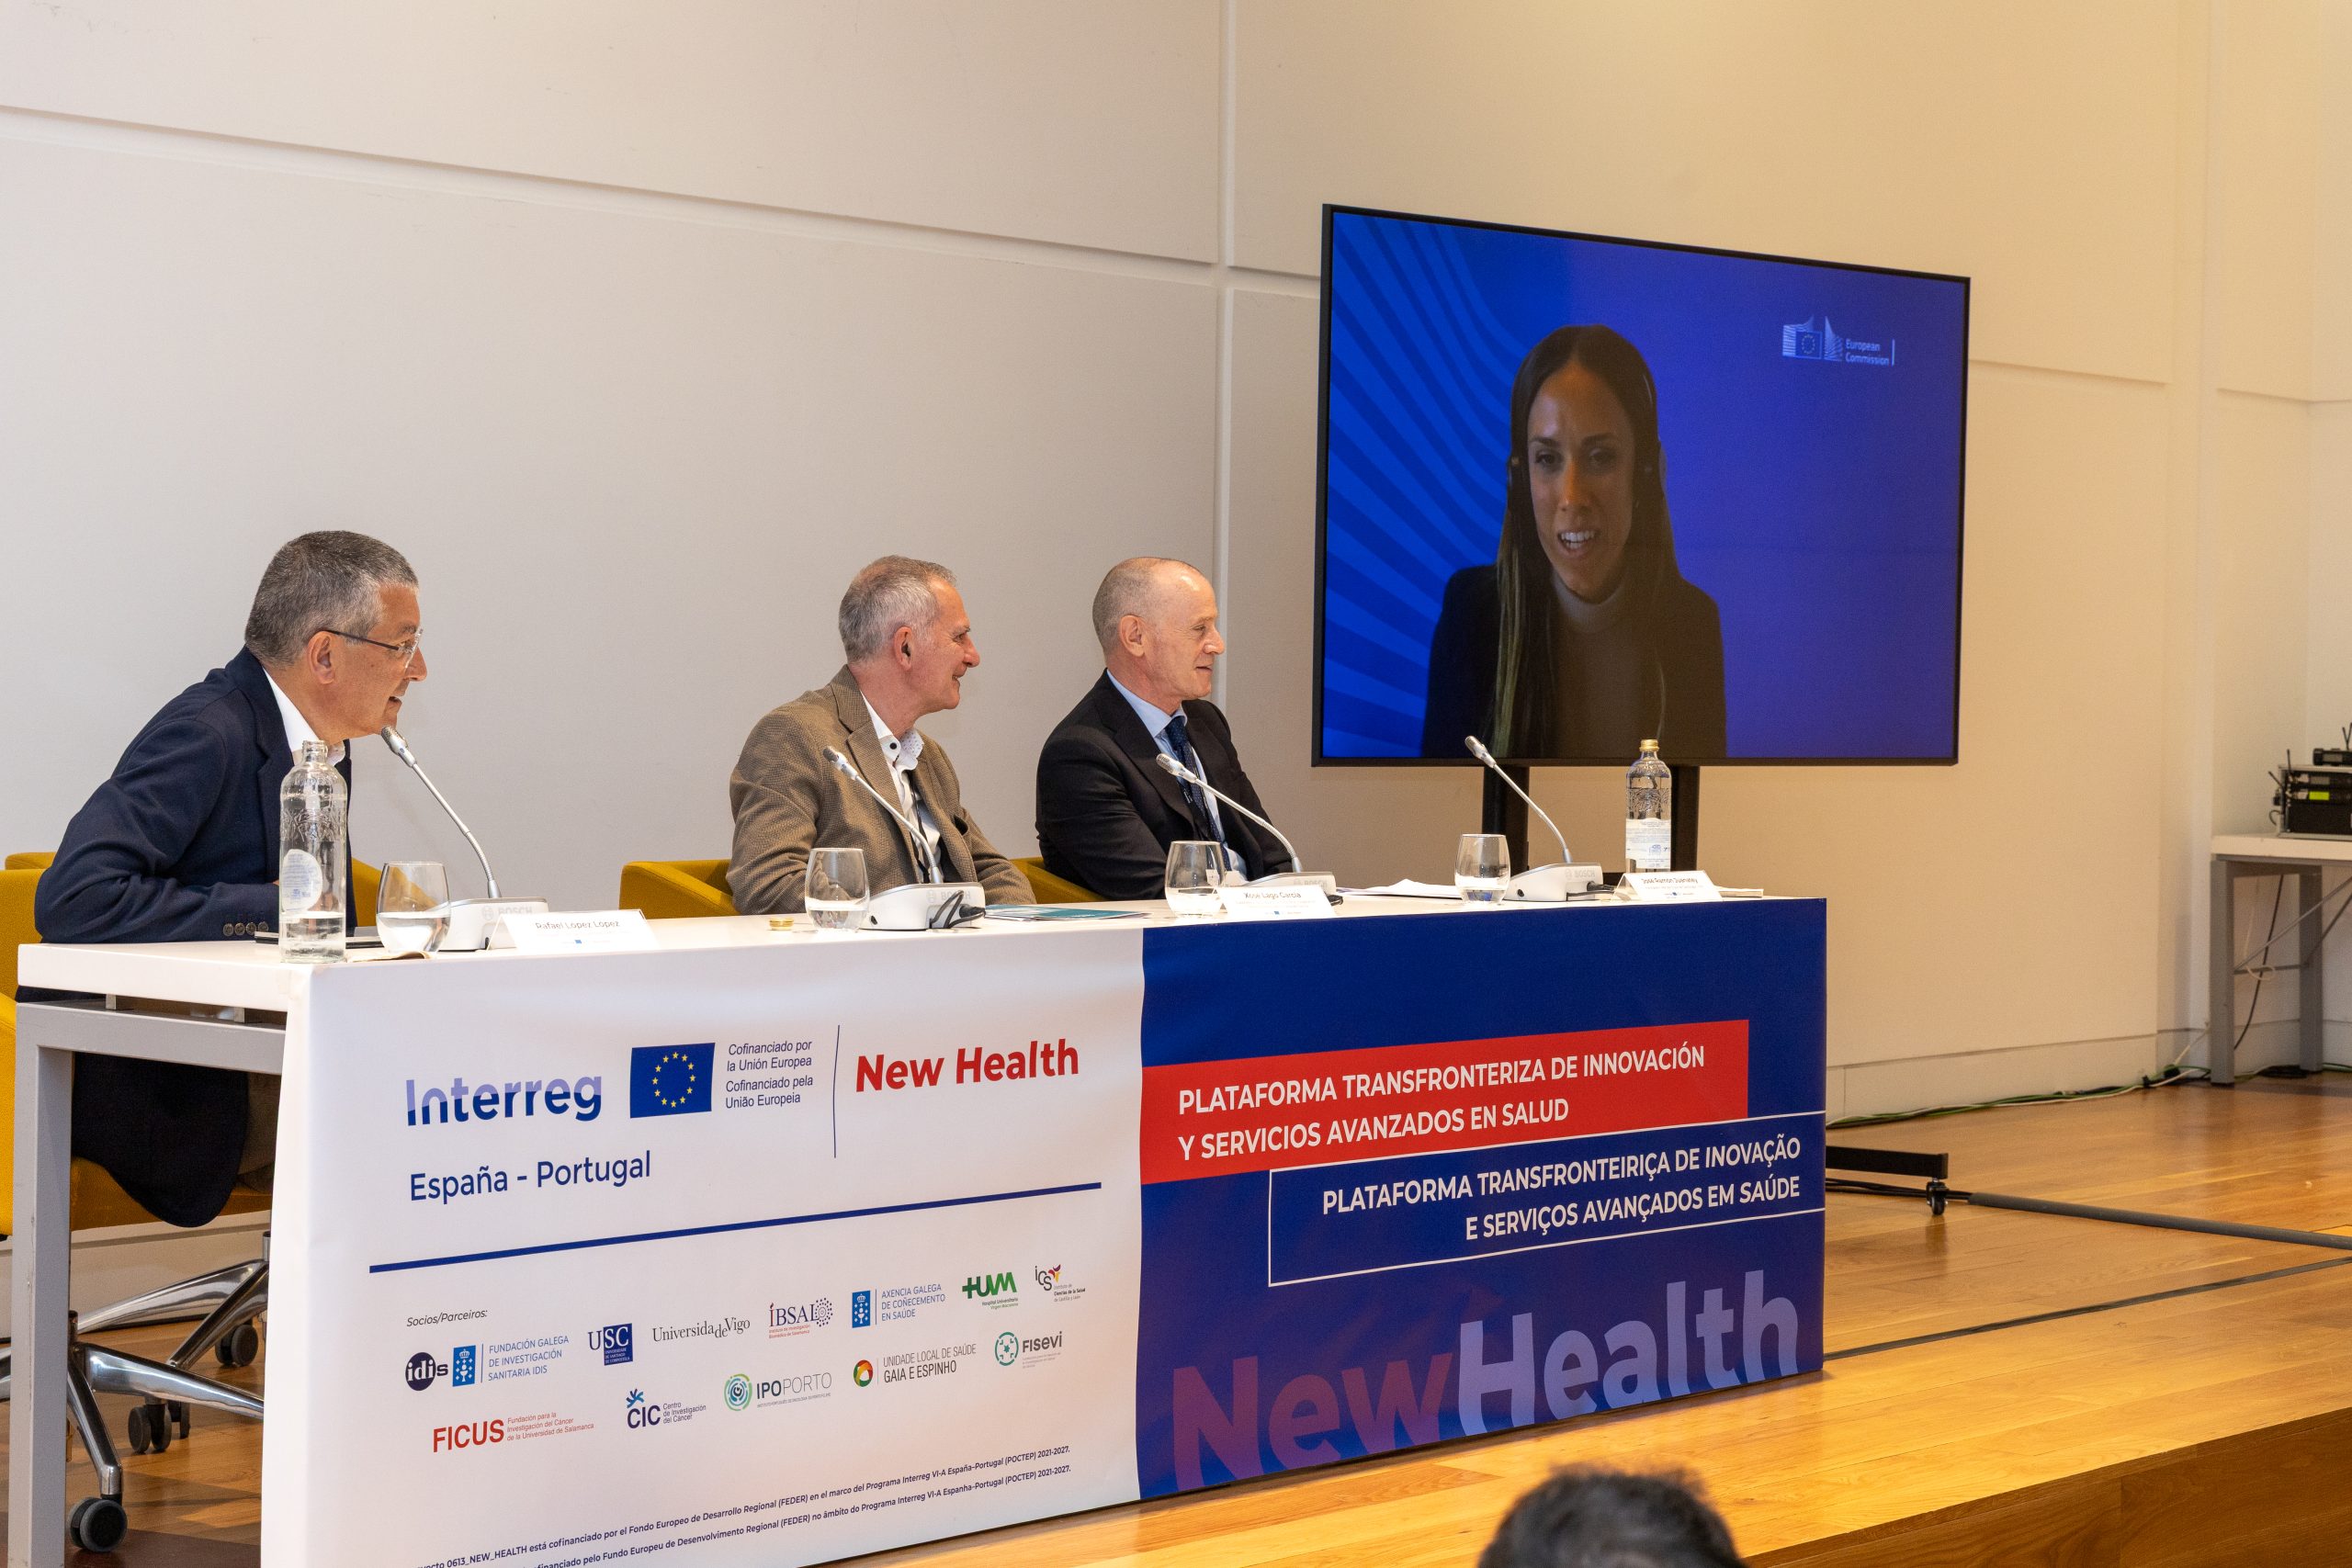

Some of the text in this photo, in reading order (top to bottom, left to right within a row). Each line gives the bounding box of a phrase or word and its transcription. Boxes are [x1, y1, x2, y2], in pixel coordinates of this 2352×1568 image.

[1845, 338, 1881, 352] European
[1845, 352, 1890, 366] Commission
[729, 1039, 812, 1055] Cofinanciado por
[727, 1055, 812, 1073] la Unión Europea
[855, 1038, 1080, 1092] New Health
[726, 1074, 814, 1093] Cofinanciado pela
[1179, 1041, 1705, 1115] PLATAFORMA TRANSFRONTERIZA DE INNOVACIÓN
[405, 1075, 602, 1127] Interreg
[725, 1091, 801, 1110] União Europeia
[1178, 1098, 1569, 1161] Y SERVICIOS AVANZADOS EN SALUD
[410, 1166, 508, 1205] España
[537, 1150, 651, 1189] Portugal
[1323, 1133, 1802, 1215] PLATAFORMA TRANSFRONTEIRIÇA DE INOVAÇÃO
[1465, 1174, 1801, 1241] E SERVIÇOS AVANÇADOS EM SAÚDE
[881, 1283, 943, 1299] AXENCIA GALEGA
[881, 1292, 946, 1311] DE COÑECEMENTO
[406, 1309, 488, 1327] Socios/Parceiros:
[881, 1307, 916, 1322] EN SAÚDE
[489, 1335, 570, 1355] FUNDACIÓN GALEGA
[587, 1325, 628, 1350] USC
[489, 1349, 562, 1368] DE INVESTIGACIÓN
[883, 1342, 977, 1368] UNIDADE LOCAL DE SAÚDE
[406, 1359, 448, 1382] idis
[488, 1365, 548, 1382] SANITARIA IDIS
[884, 1359, 957, 1383] GAIA E ESPINHO
[663, 1401, 682, 1411] Centro
[672, 1404, 707, 1416] Investigación
[507, 1415, 537, 1425] Fundación
[537, 1412, 550, 1421] para
[627, 1404, 661, 1429] CIC
[663, 1416, 672, 1424] del
[432, 1419, 505, 1453] FICUS
[507, 1422, 544, 1433] Investigación
[522, 1429, 555, 1439] Universidad
[564, 1423, 594, 1433] Salamanca
[529, 1541, 547, 1552] está
[548, 1530, 602, 1550] cofinanciado
[604, 1529, 618, 1541] por
[619, 1526, 628, 1536] el
[628, 1521, 654, 1535] Fondo
[656, 1516, 689, 1531] Europeo
[691, 1513, 701, 1523] de
[703, 1506, 742, 1521] Desarrollo
[743, 1499, 777, 1516] Regional
[778, 1493, 808, 1508] (FEDER)
[809, 1492, 820, 1501] en
[820, 1489, 828, 1499] el
[829, 1486, 852, 1498] marco
[853, 1483, 865, 1494] del
[865, 1477, 900, 1494] Programa
[902, 1472, 931, 1486] Interreg
[932, 1469, 946, 1478] VI-A
[1005, 1451, 1036, 1467] (POCTEP)
[583, 1552, 602, 1565] pelo
[603, 1547, 628, 1562] Fundo
[630, 1541, 663, 1558] Europeu
[665, 1540, 675, 1550] de
[677, 1527, 744, 1547] Desenvolvimento
[745, 1519, 779, 1536] Regional
[780, 1513, 810, 1529] (FEDER)
[812, 1512, 821, 1521] no
[823, 1506, 849, 1520] âmbito
[851, 1503, 860, 1514] do
[861, 1497, 896, 1515] Programa
[898, 1492, 926, 1506] Interreg
[927, 1488, 942, 1498] VI-A
[1005, 1471, 1036, 1486] (POCTEP)
